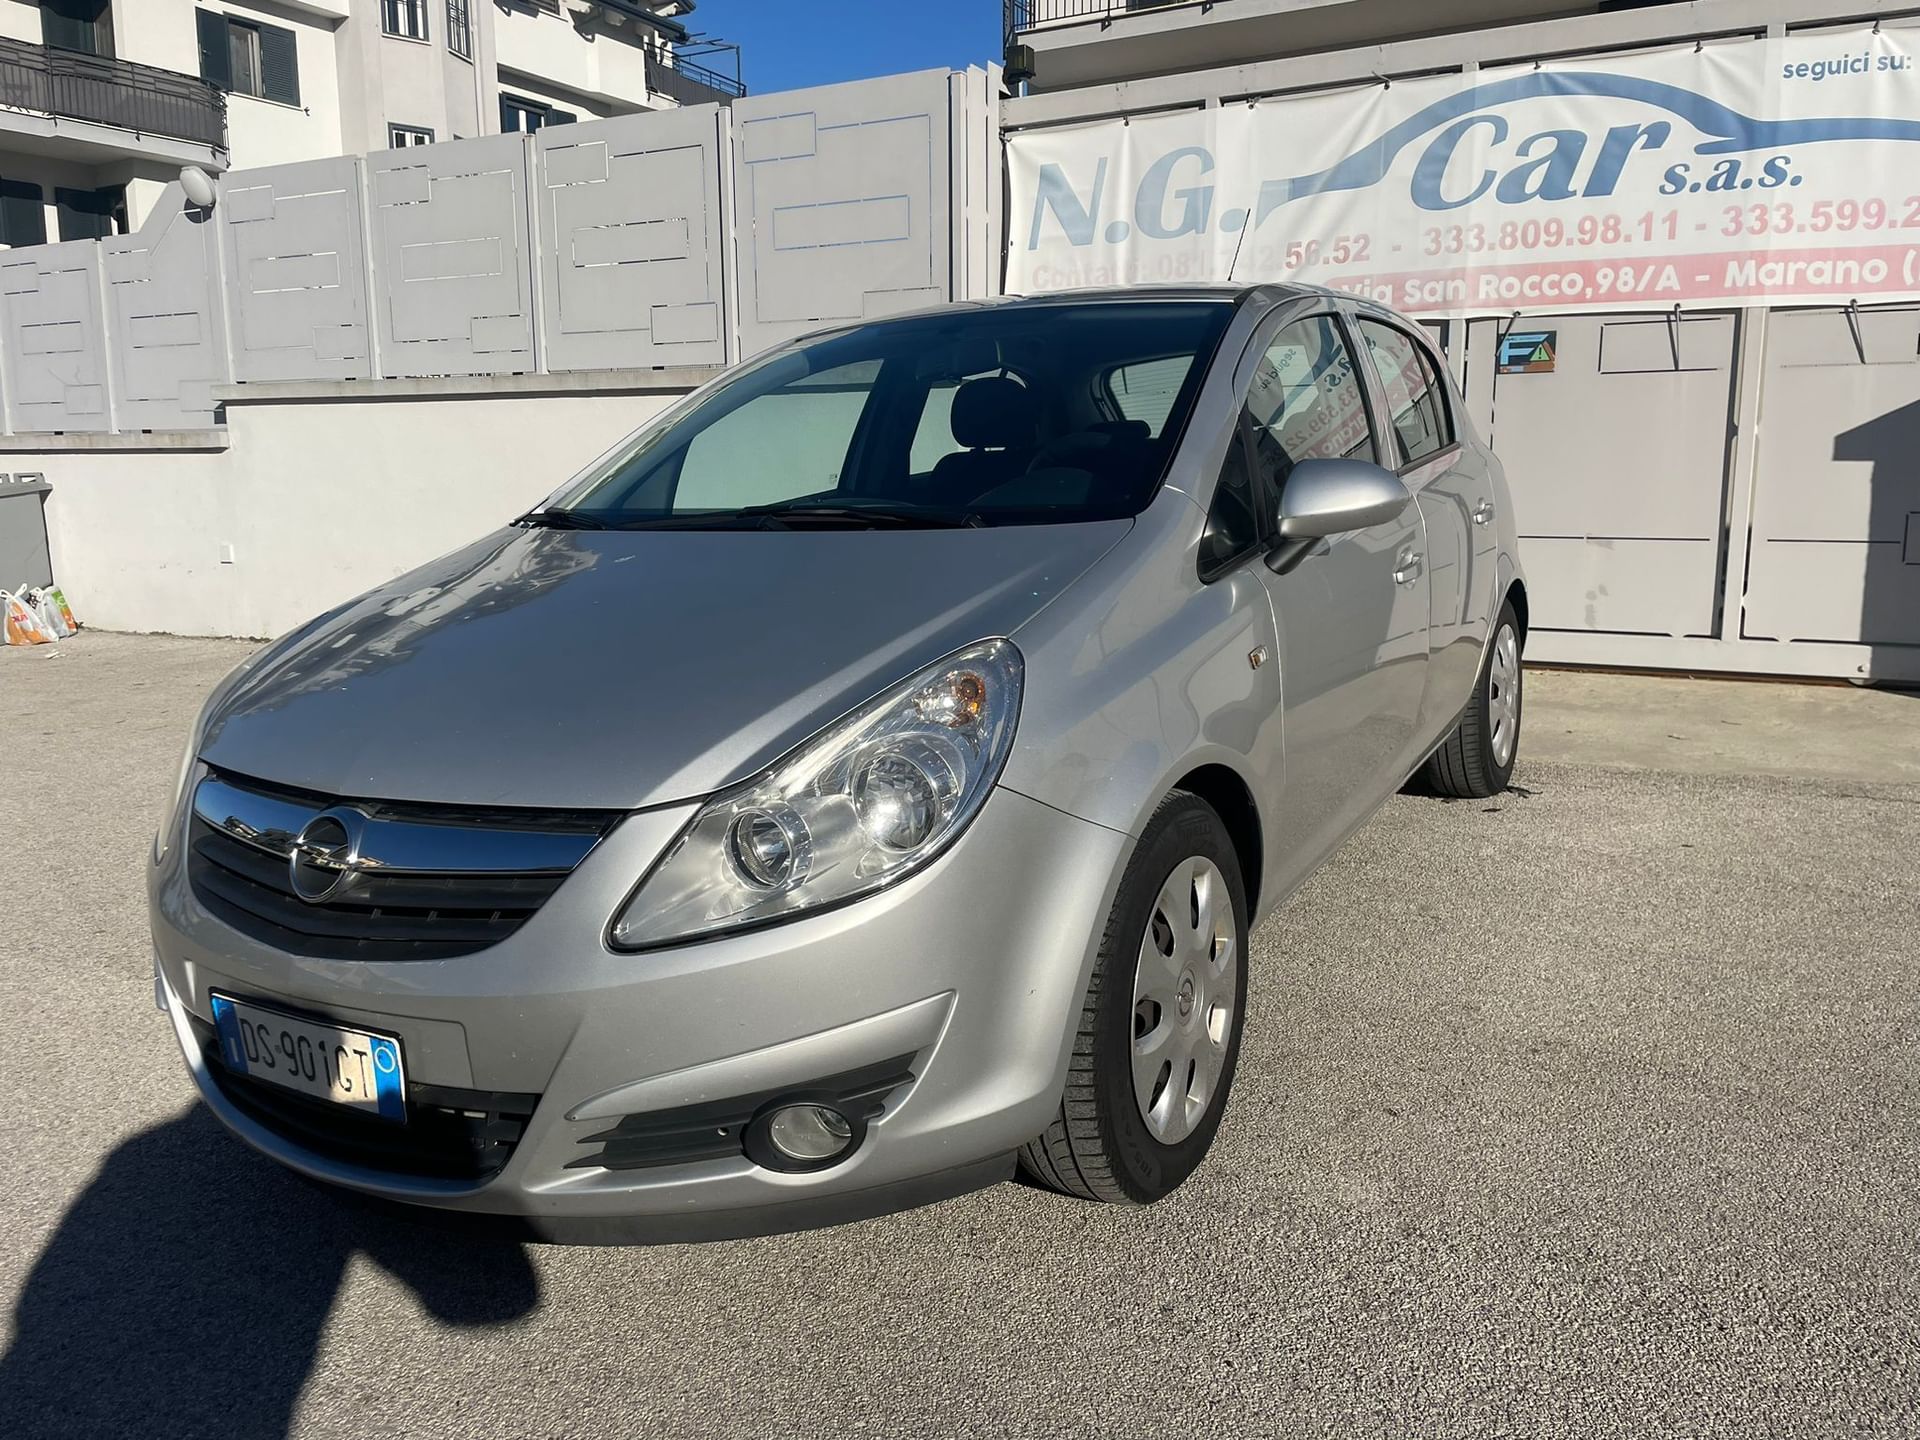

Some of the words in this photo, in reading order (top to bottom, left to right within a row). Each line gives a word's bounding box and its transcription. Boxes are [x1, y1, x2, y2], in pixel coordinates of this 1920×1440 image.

[1783, 51, 1870, 81] seguici
[1876, 53, 1912, 71] su:
[1028, 146, 1246, 251] N.G.
[1410, 115, 1672, 211] Car
[1658, 155, 1803, 195] s.a.s.
[1424, 208, 1679, 256] 333.809.98.11
[1403, 277, 1466, 305] San
[1724, 257, 1888, 289] Marano
